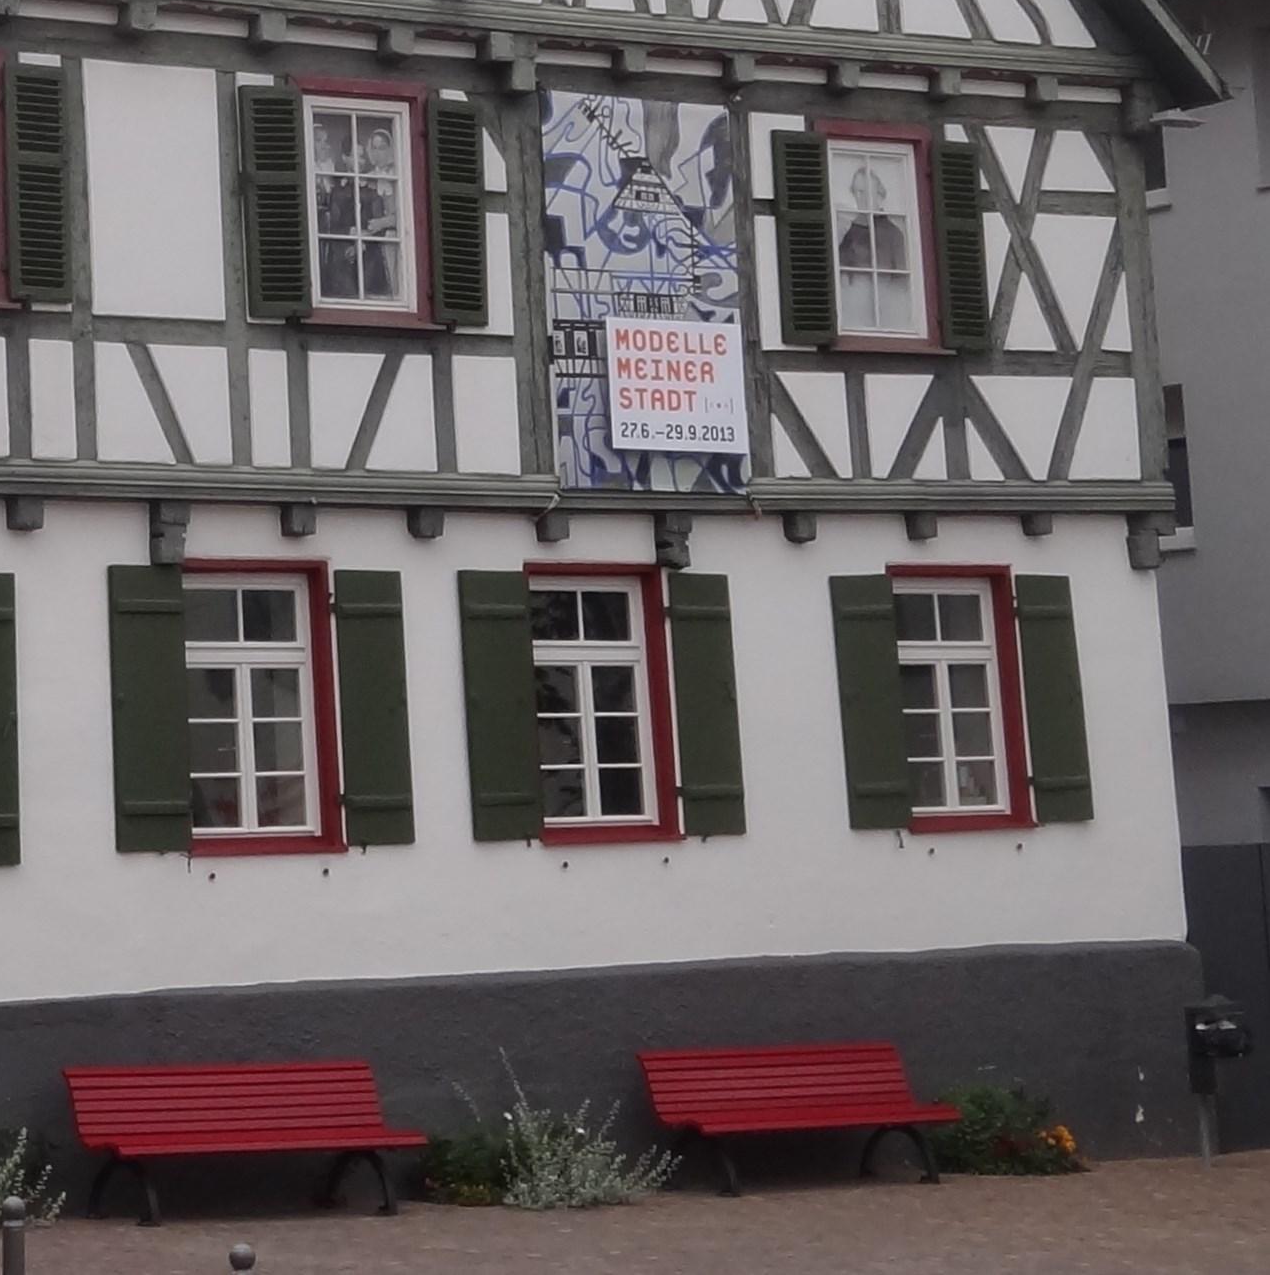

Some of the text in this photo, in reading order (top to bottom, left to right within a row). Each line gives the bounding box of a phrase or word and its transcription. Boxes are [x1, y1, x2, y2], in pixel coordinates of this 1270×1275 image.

[615, 328, 727, 356] MODELLE
[617, 356, 715, 384] MEINER
[619, 387, 697, 412] STADT
